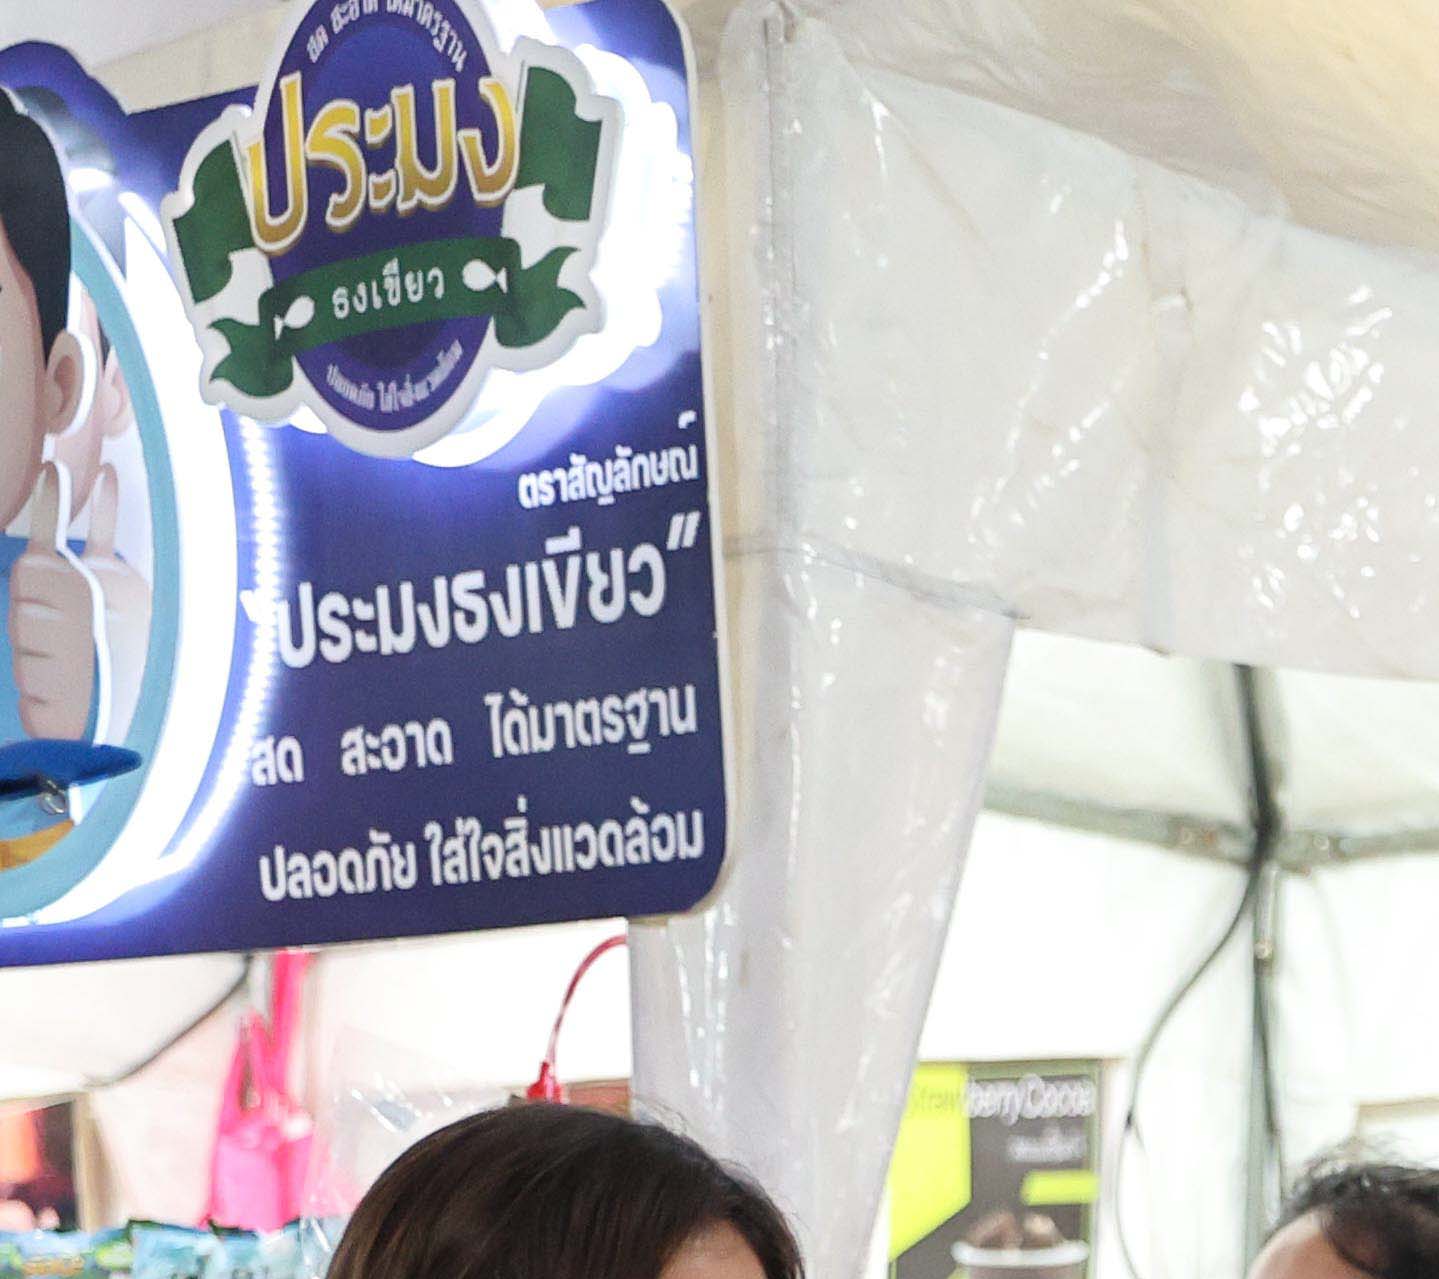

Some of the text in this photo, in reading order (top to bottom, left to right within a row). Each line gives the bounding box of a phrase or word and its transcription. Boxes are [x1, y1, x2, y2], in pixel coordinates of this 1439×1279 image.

[247, 70, 520, 256] ประมง
[332, 257, 445, 319] ธงเขียว
[518, 409, 700, 509] ตราสัญลักษณ์
[252, 683, 698, 786] สด สะอาด ได้มาตรฐาน
[259, 794, 705, 901] ปลอดภัย ใส่ใจสิ่งแวดล้อม
